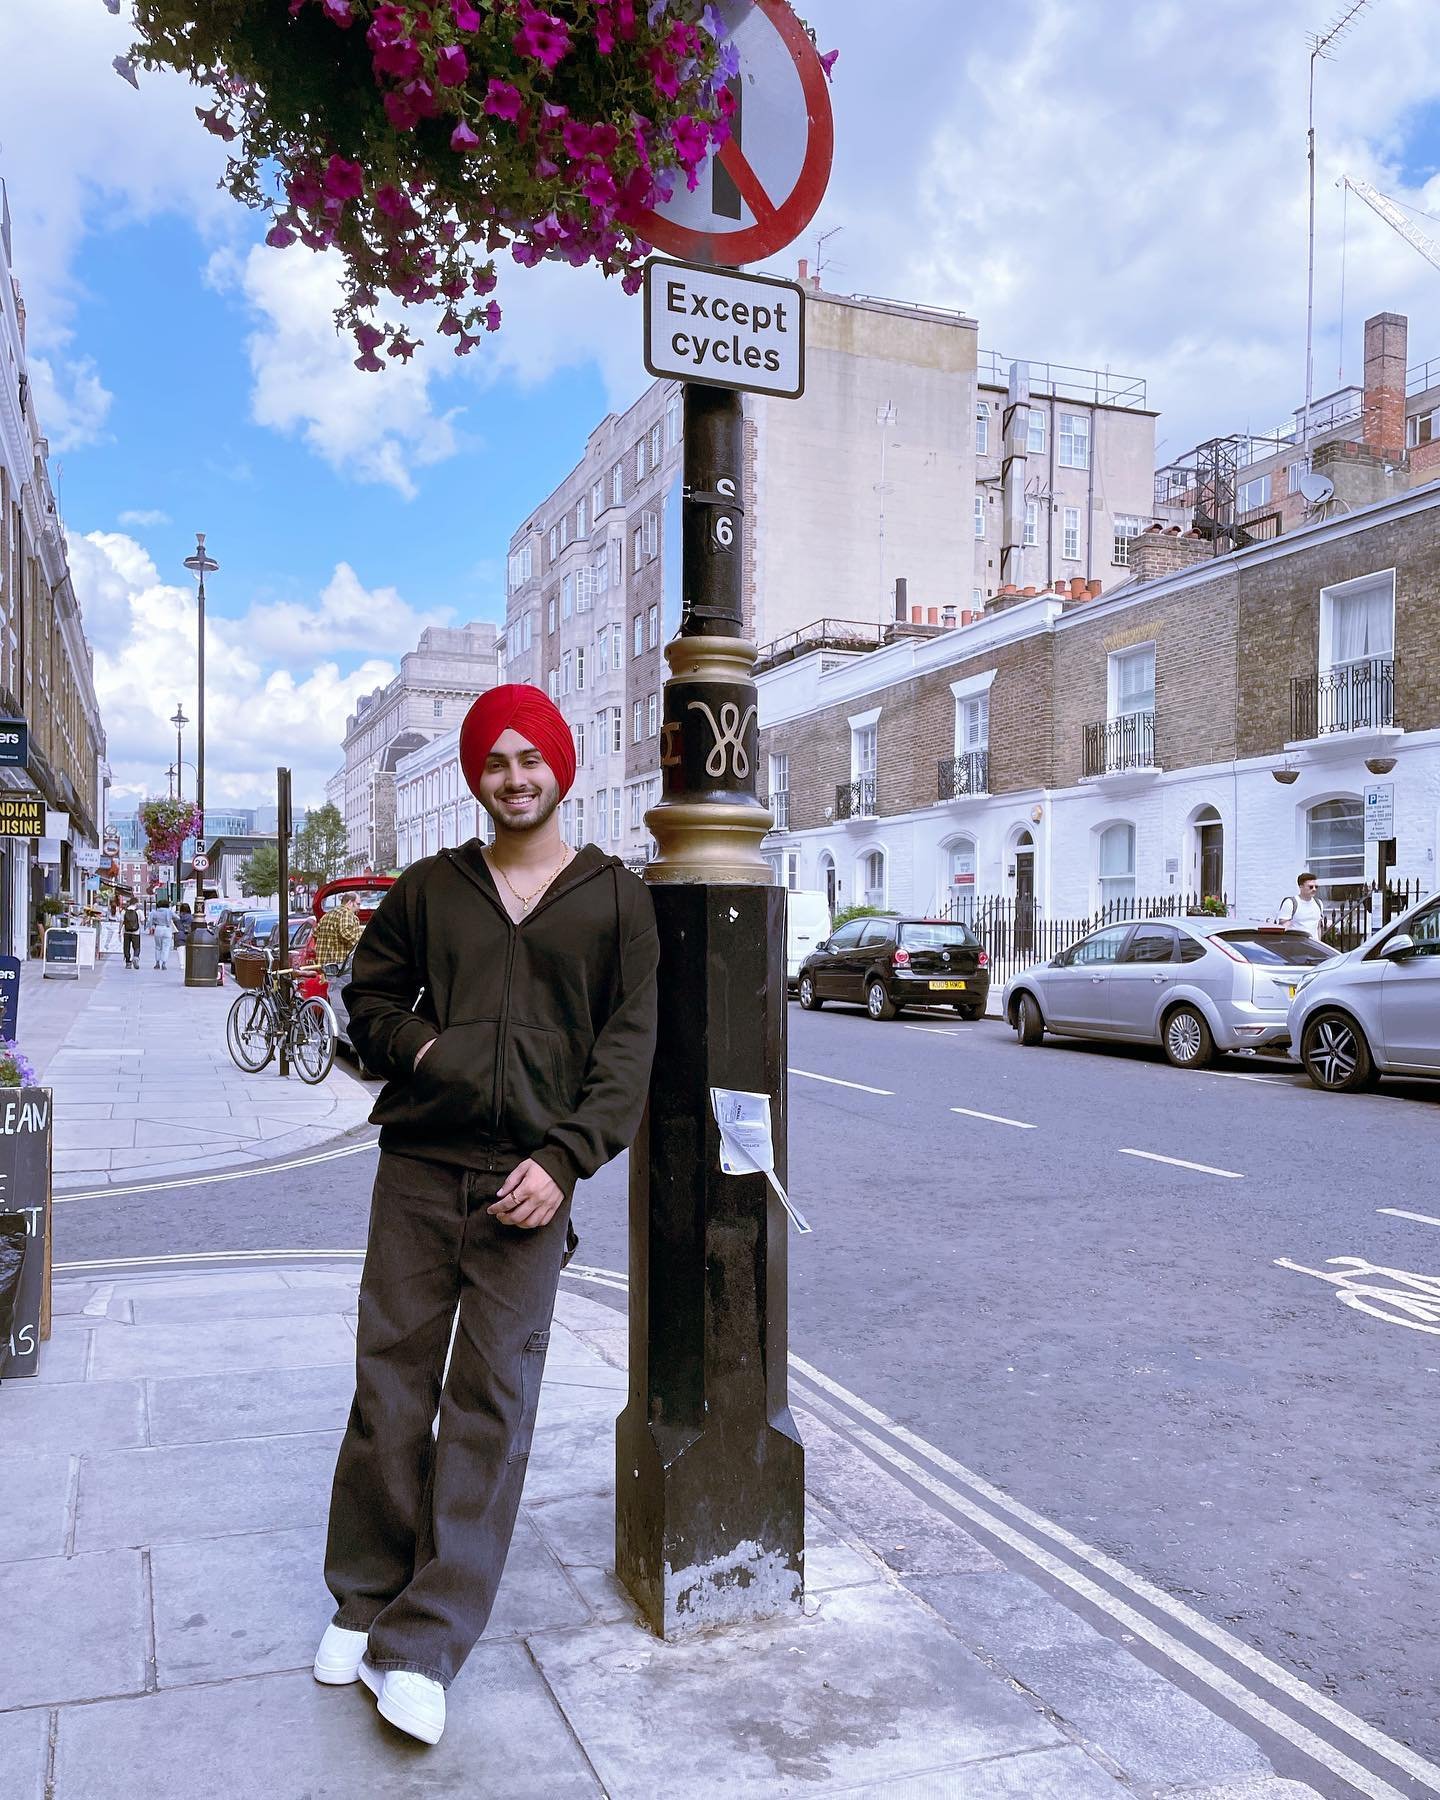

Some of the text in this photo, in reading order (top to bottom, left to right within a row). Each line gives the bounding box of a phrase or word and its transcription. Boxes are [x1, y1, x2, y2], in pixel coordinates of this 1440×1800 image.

[667, 281, 787, 332] Except
[671, 332, 780, 372] cycles
[716, 516, 734, 546] 6
[0, 1101, 48, 1135] EAN
